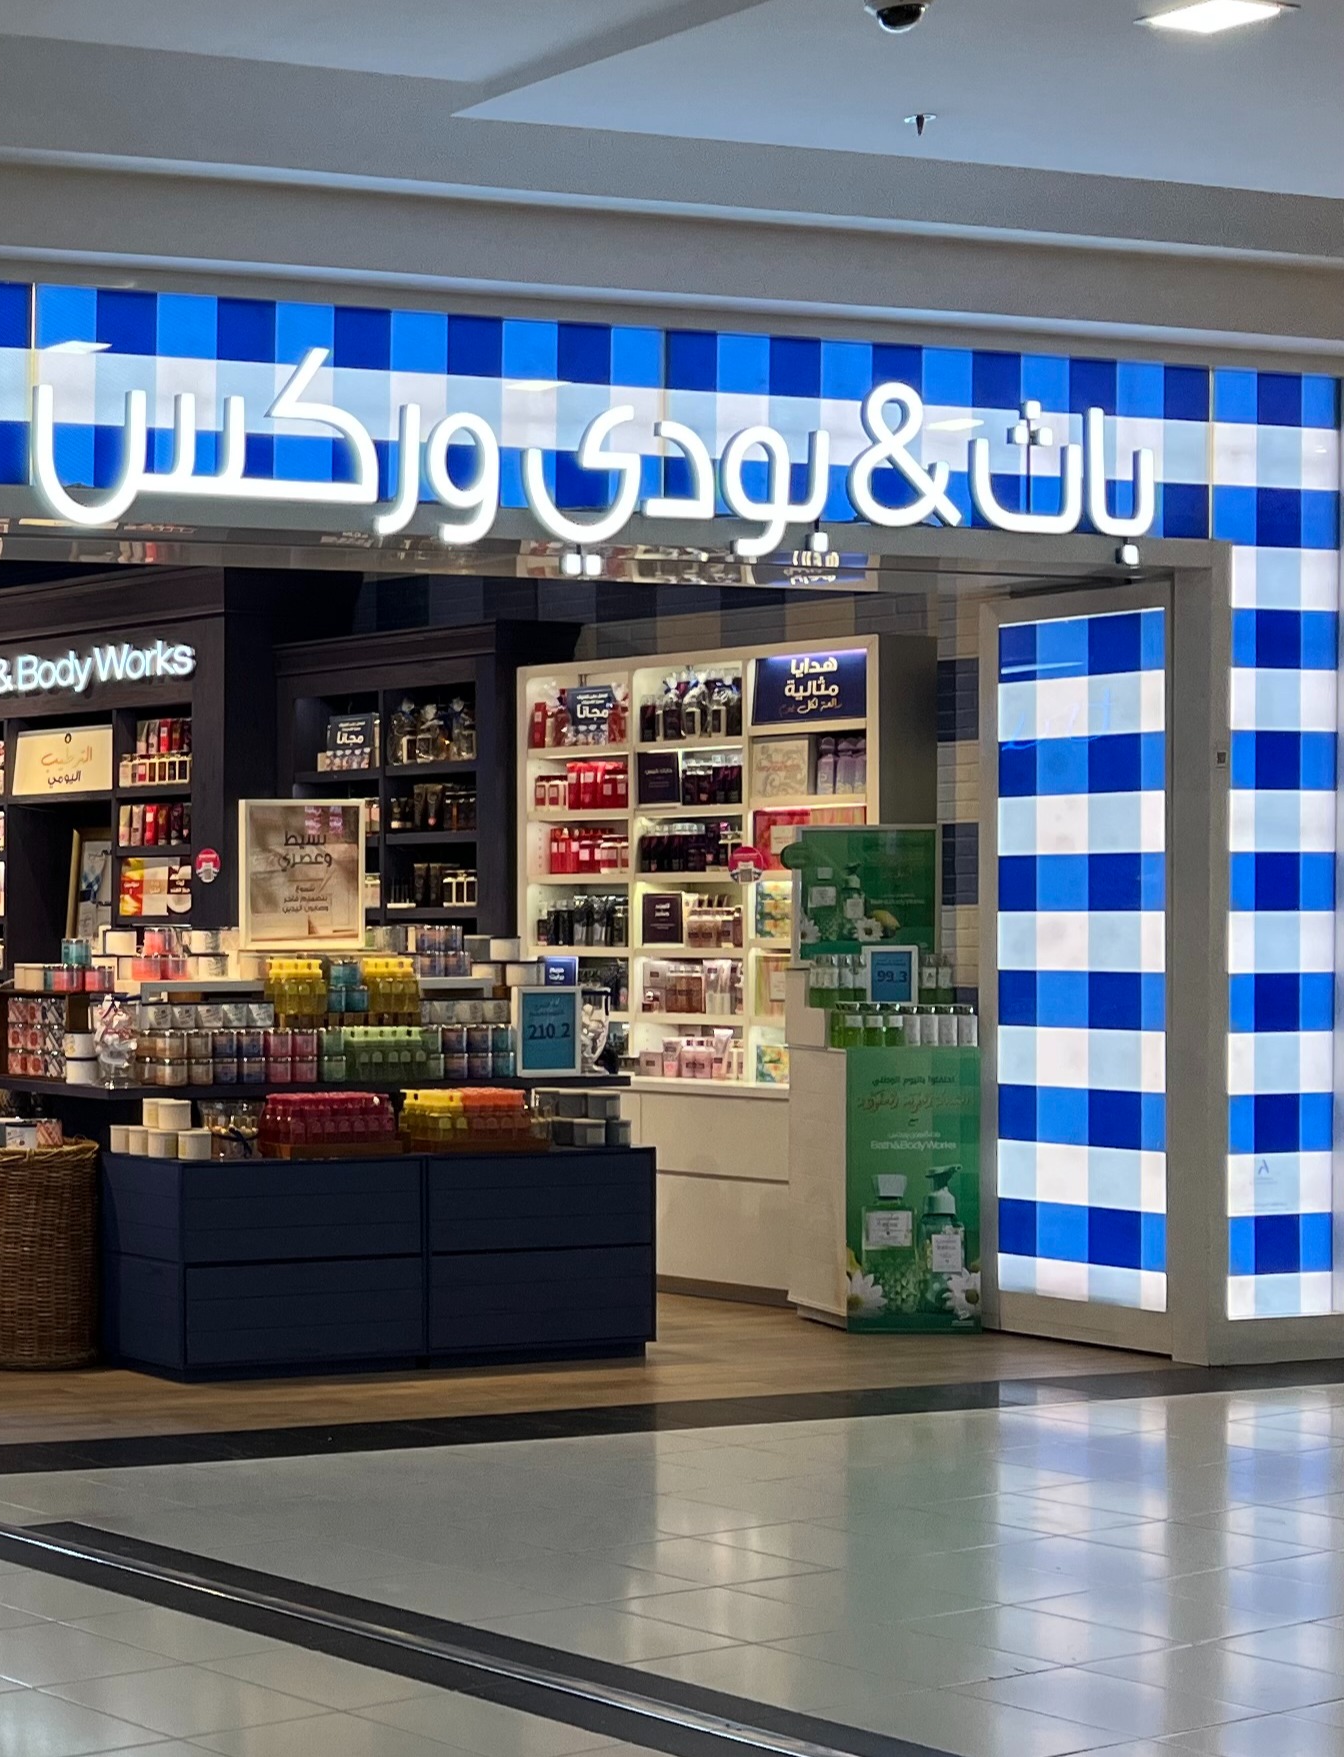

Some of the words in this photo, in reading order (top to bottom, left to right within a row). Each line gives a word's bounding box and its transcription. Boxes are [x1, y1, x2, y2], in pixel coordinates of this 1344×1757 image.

[31, 346, 502, 546] وركس
[523, 403, 830, 579] بودي
[974, 398, 1156, 566] باث
[17, 649, 93, 693] Body
[93, 639, 196, 681] Works
[784, 677, 840, 699] مثالية
[790, 656, 838, 675] هدايا
